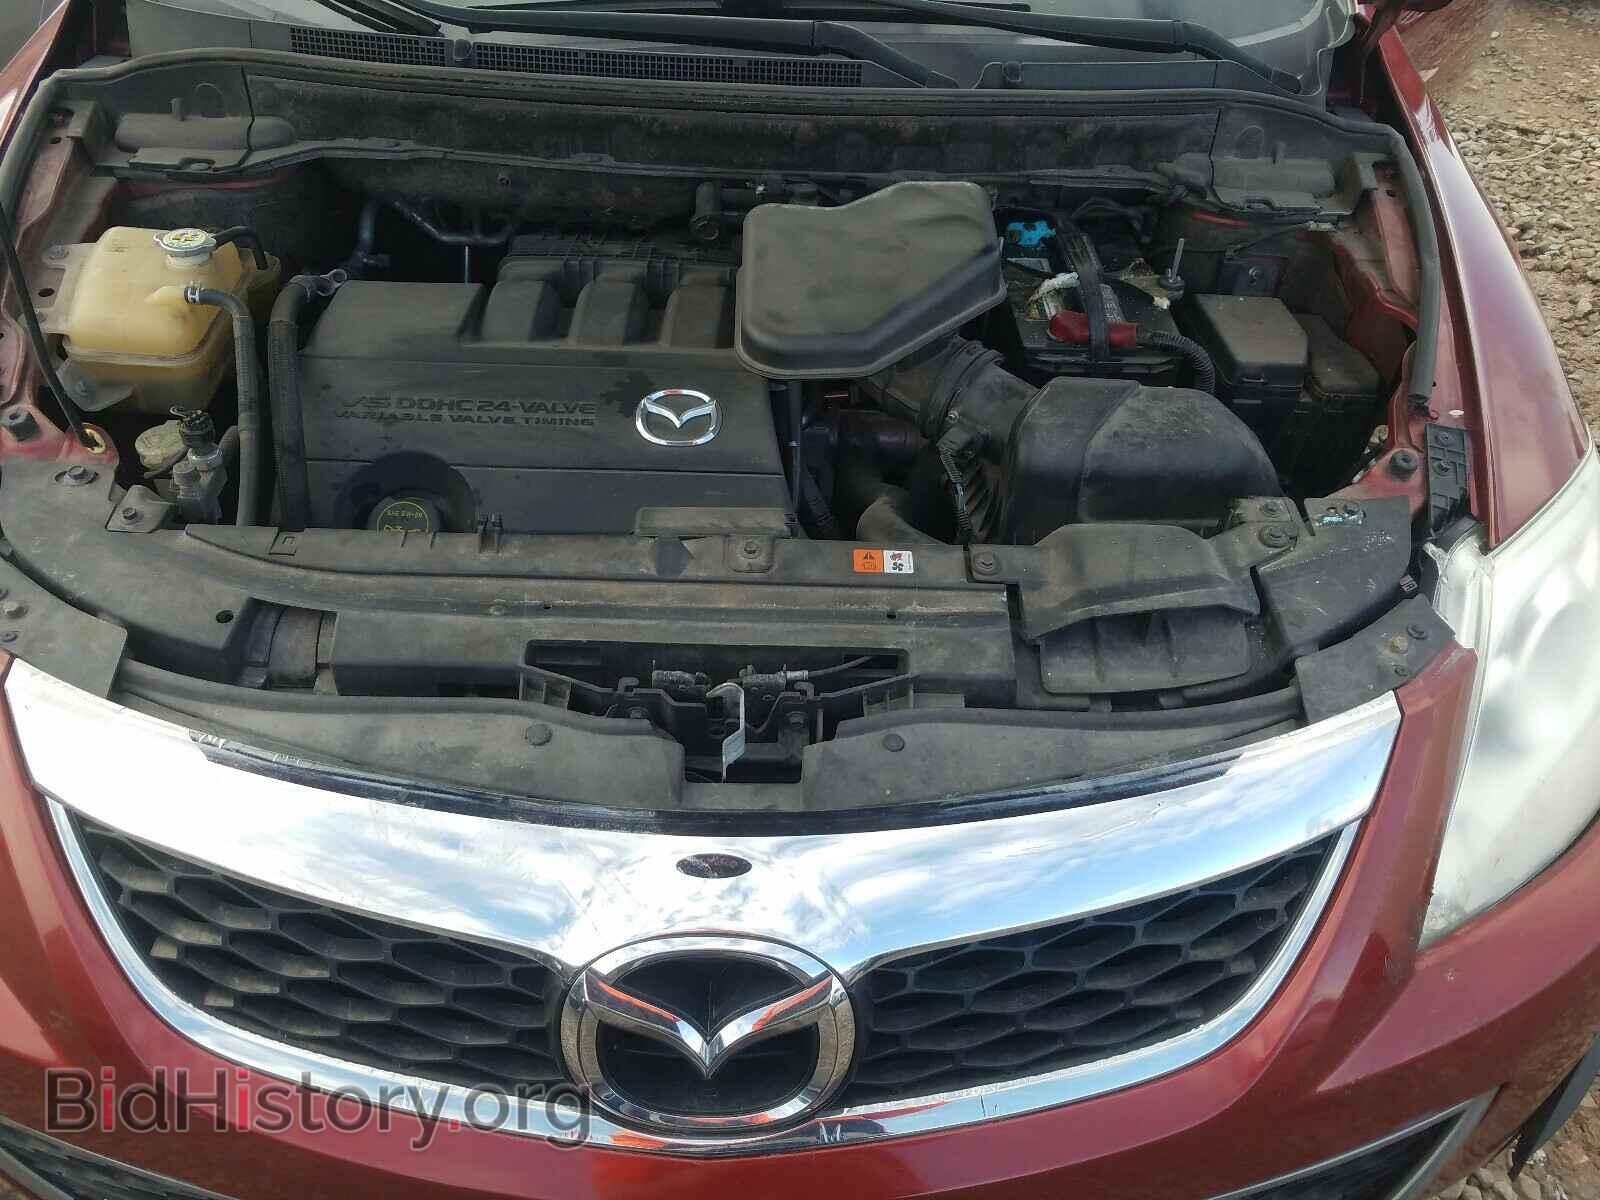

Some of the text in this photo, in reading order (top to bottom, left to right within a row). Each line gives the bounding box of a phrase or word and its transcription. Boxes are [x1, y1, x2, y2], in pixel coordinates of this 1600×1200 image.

[398, 398, 474, 412] DOHC
[476, 400, 597, 414] 24-VALVE
[448, 413, 515, 425] VALVE
[521, 415, 595, 427] TIMING
